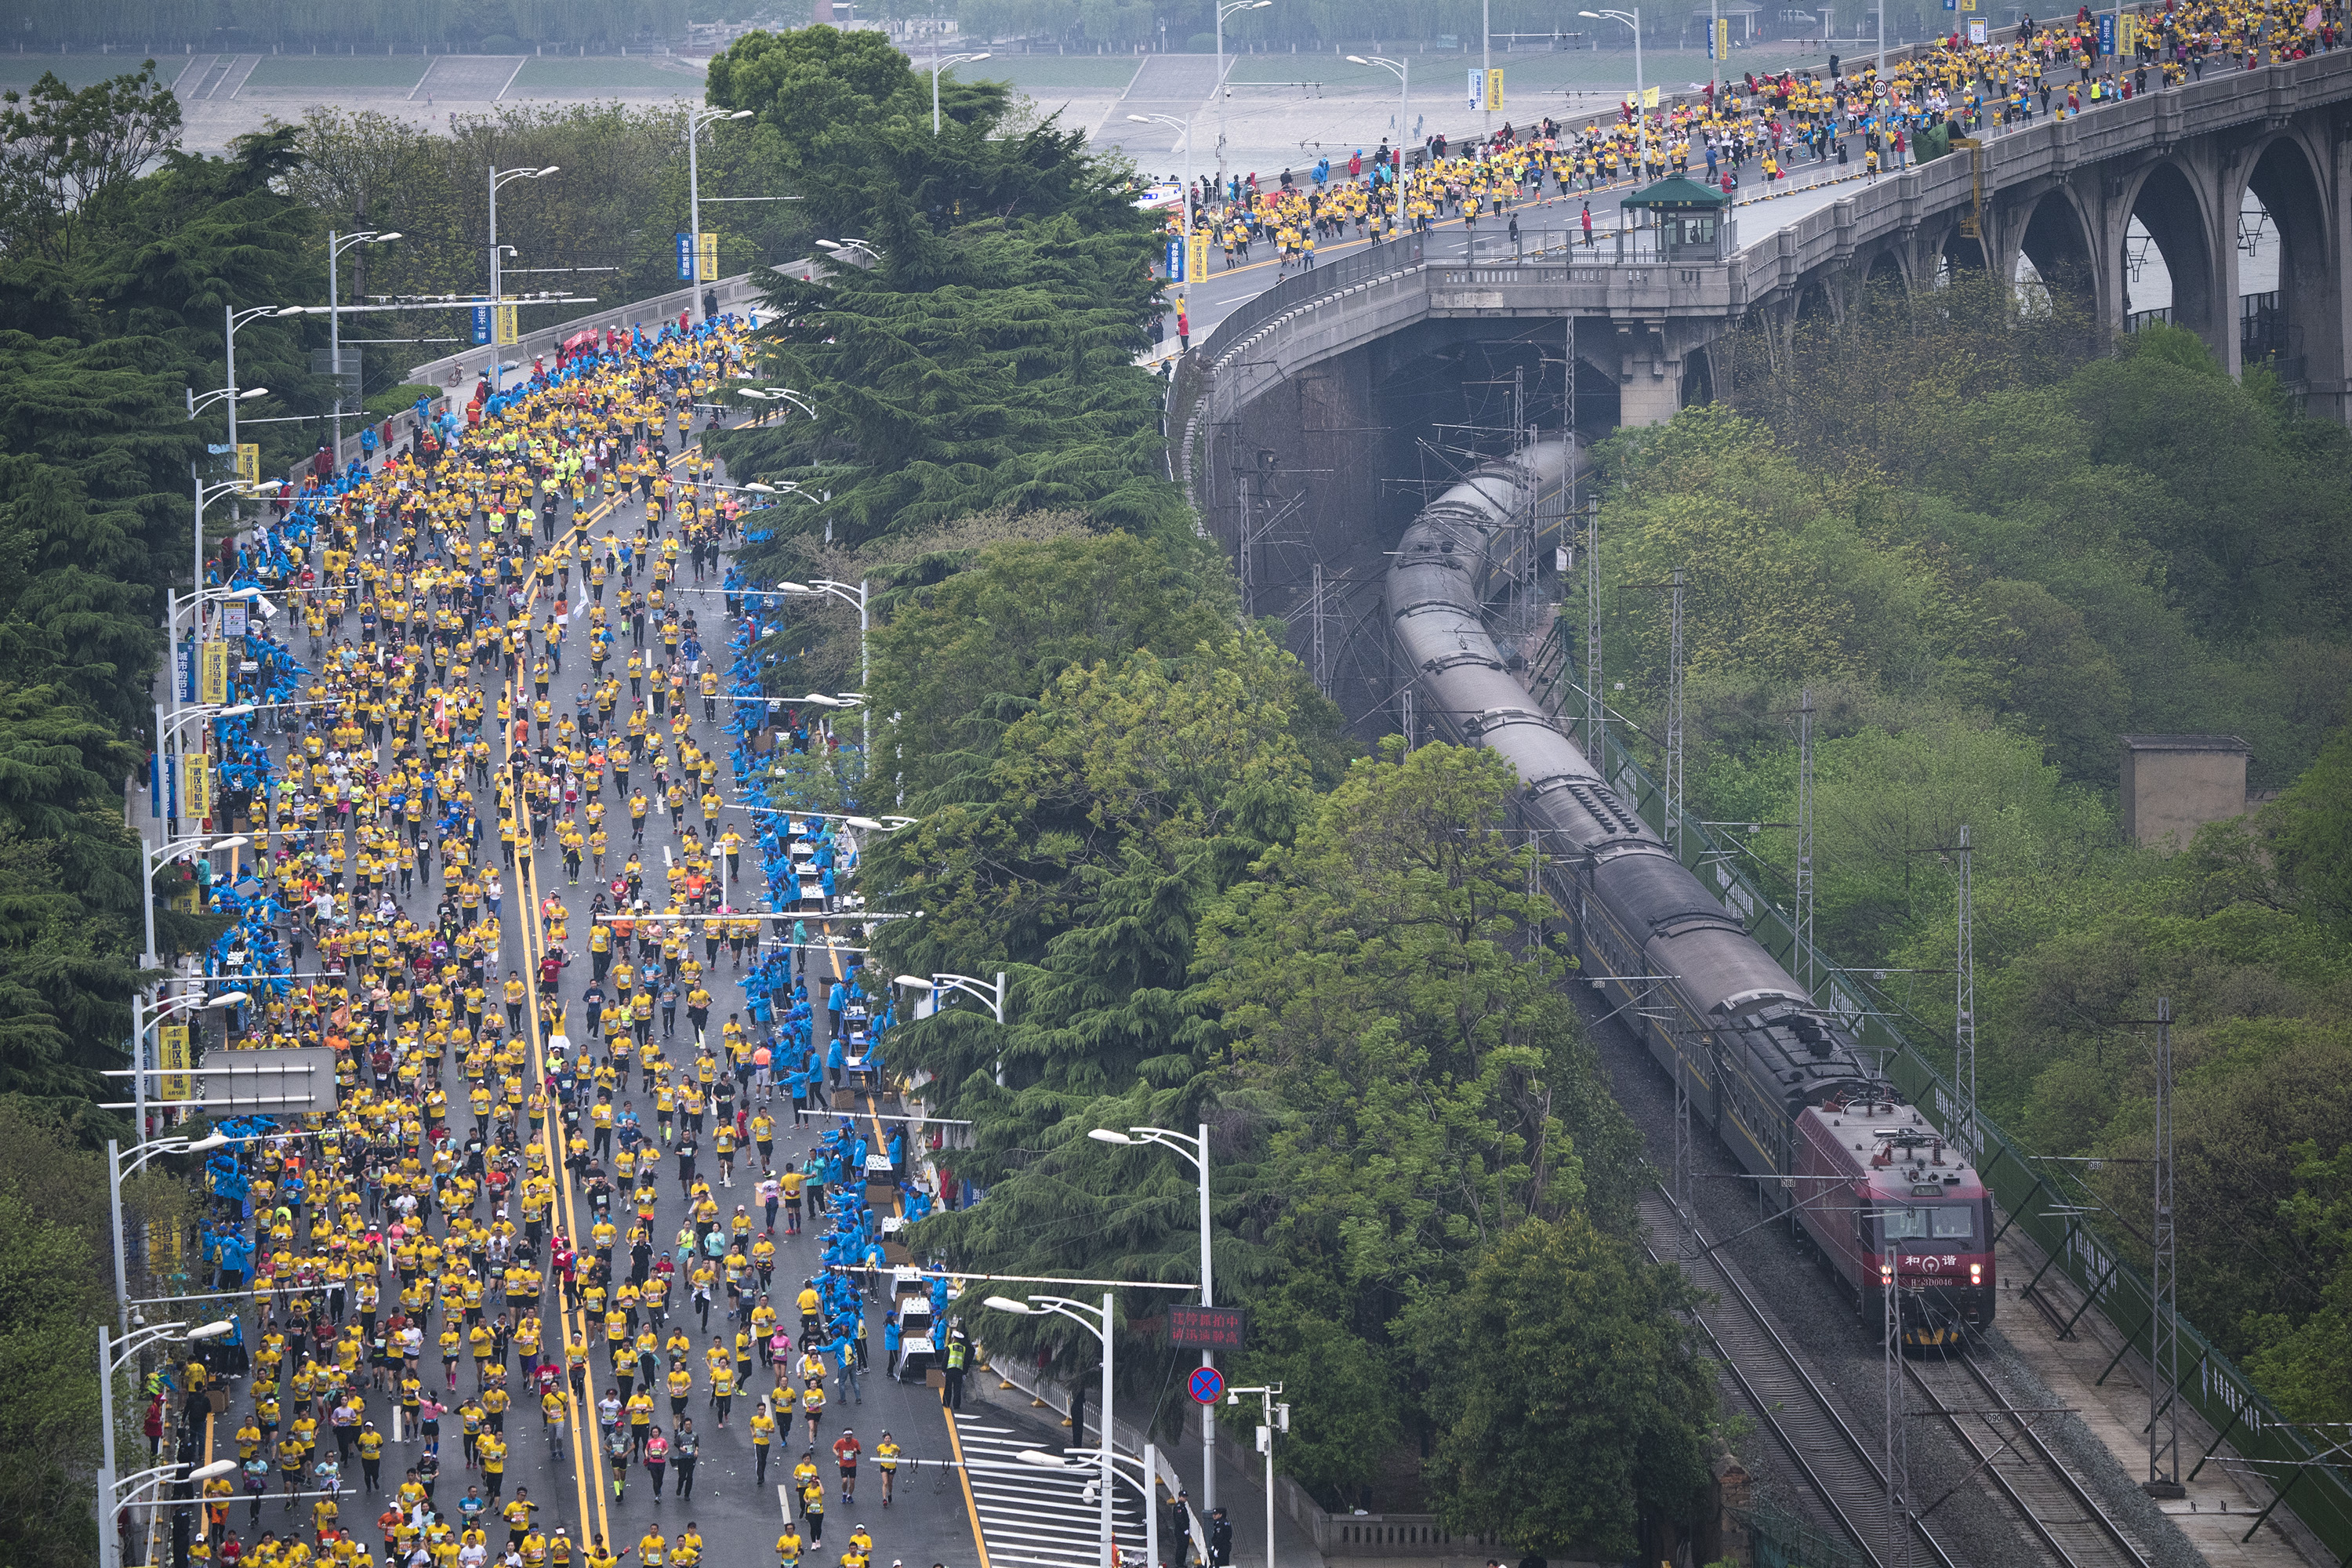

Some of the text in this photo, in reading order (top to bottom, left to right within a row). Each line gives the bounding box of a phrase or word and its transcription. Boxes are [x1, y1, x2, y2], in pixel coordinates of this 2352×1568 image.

[682, 240, 690, 276] 有你更精彩
[478, 306, 486, 340] 出不一样
[178, 652, 188, 699] 城市的节日
[213, 654, 221, 694] 武汉马拉松
[194, 767, 203, 810] 武汉马拉松
[1905, 1255, 1957, 1266] 和 谐
